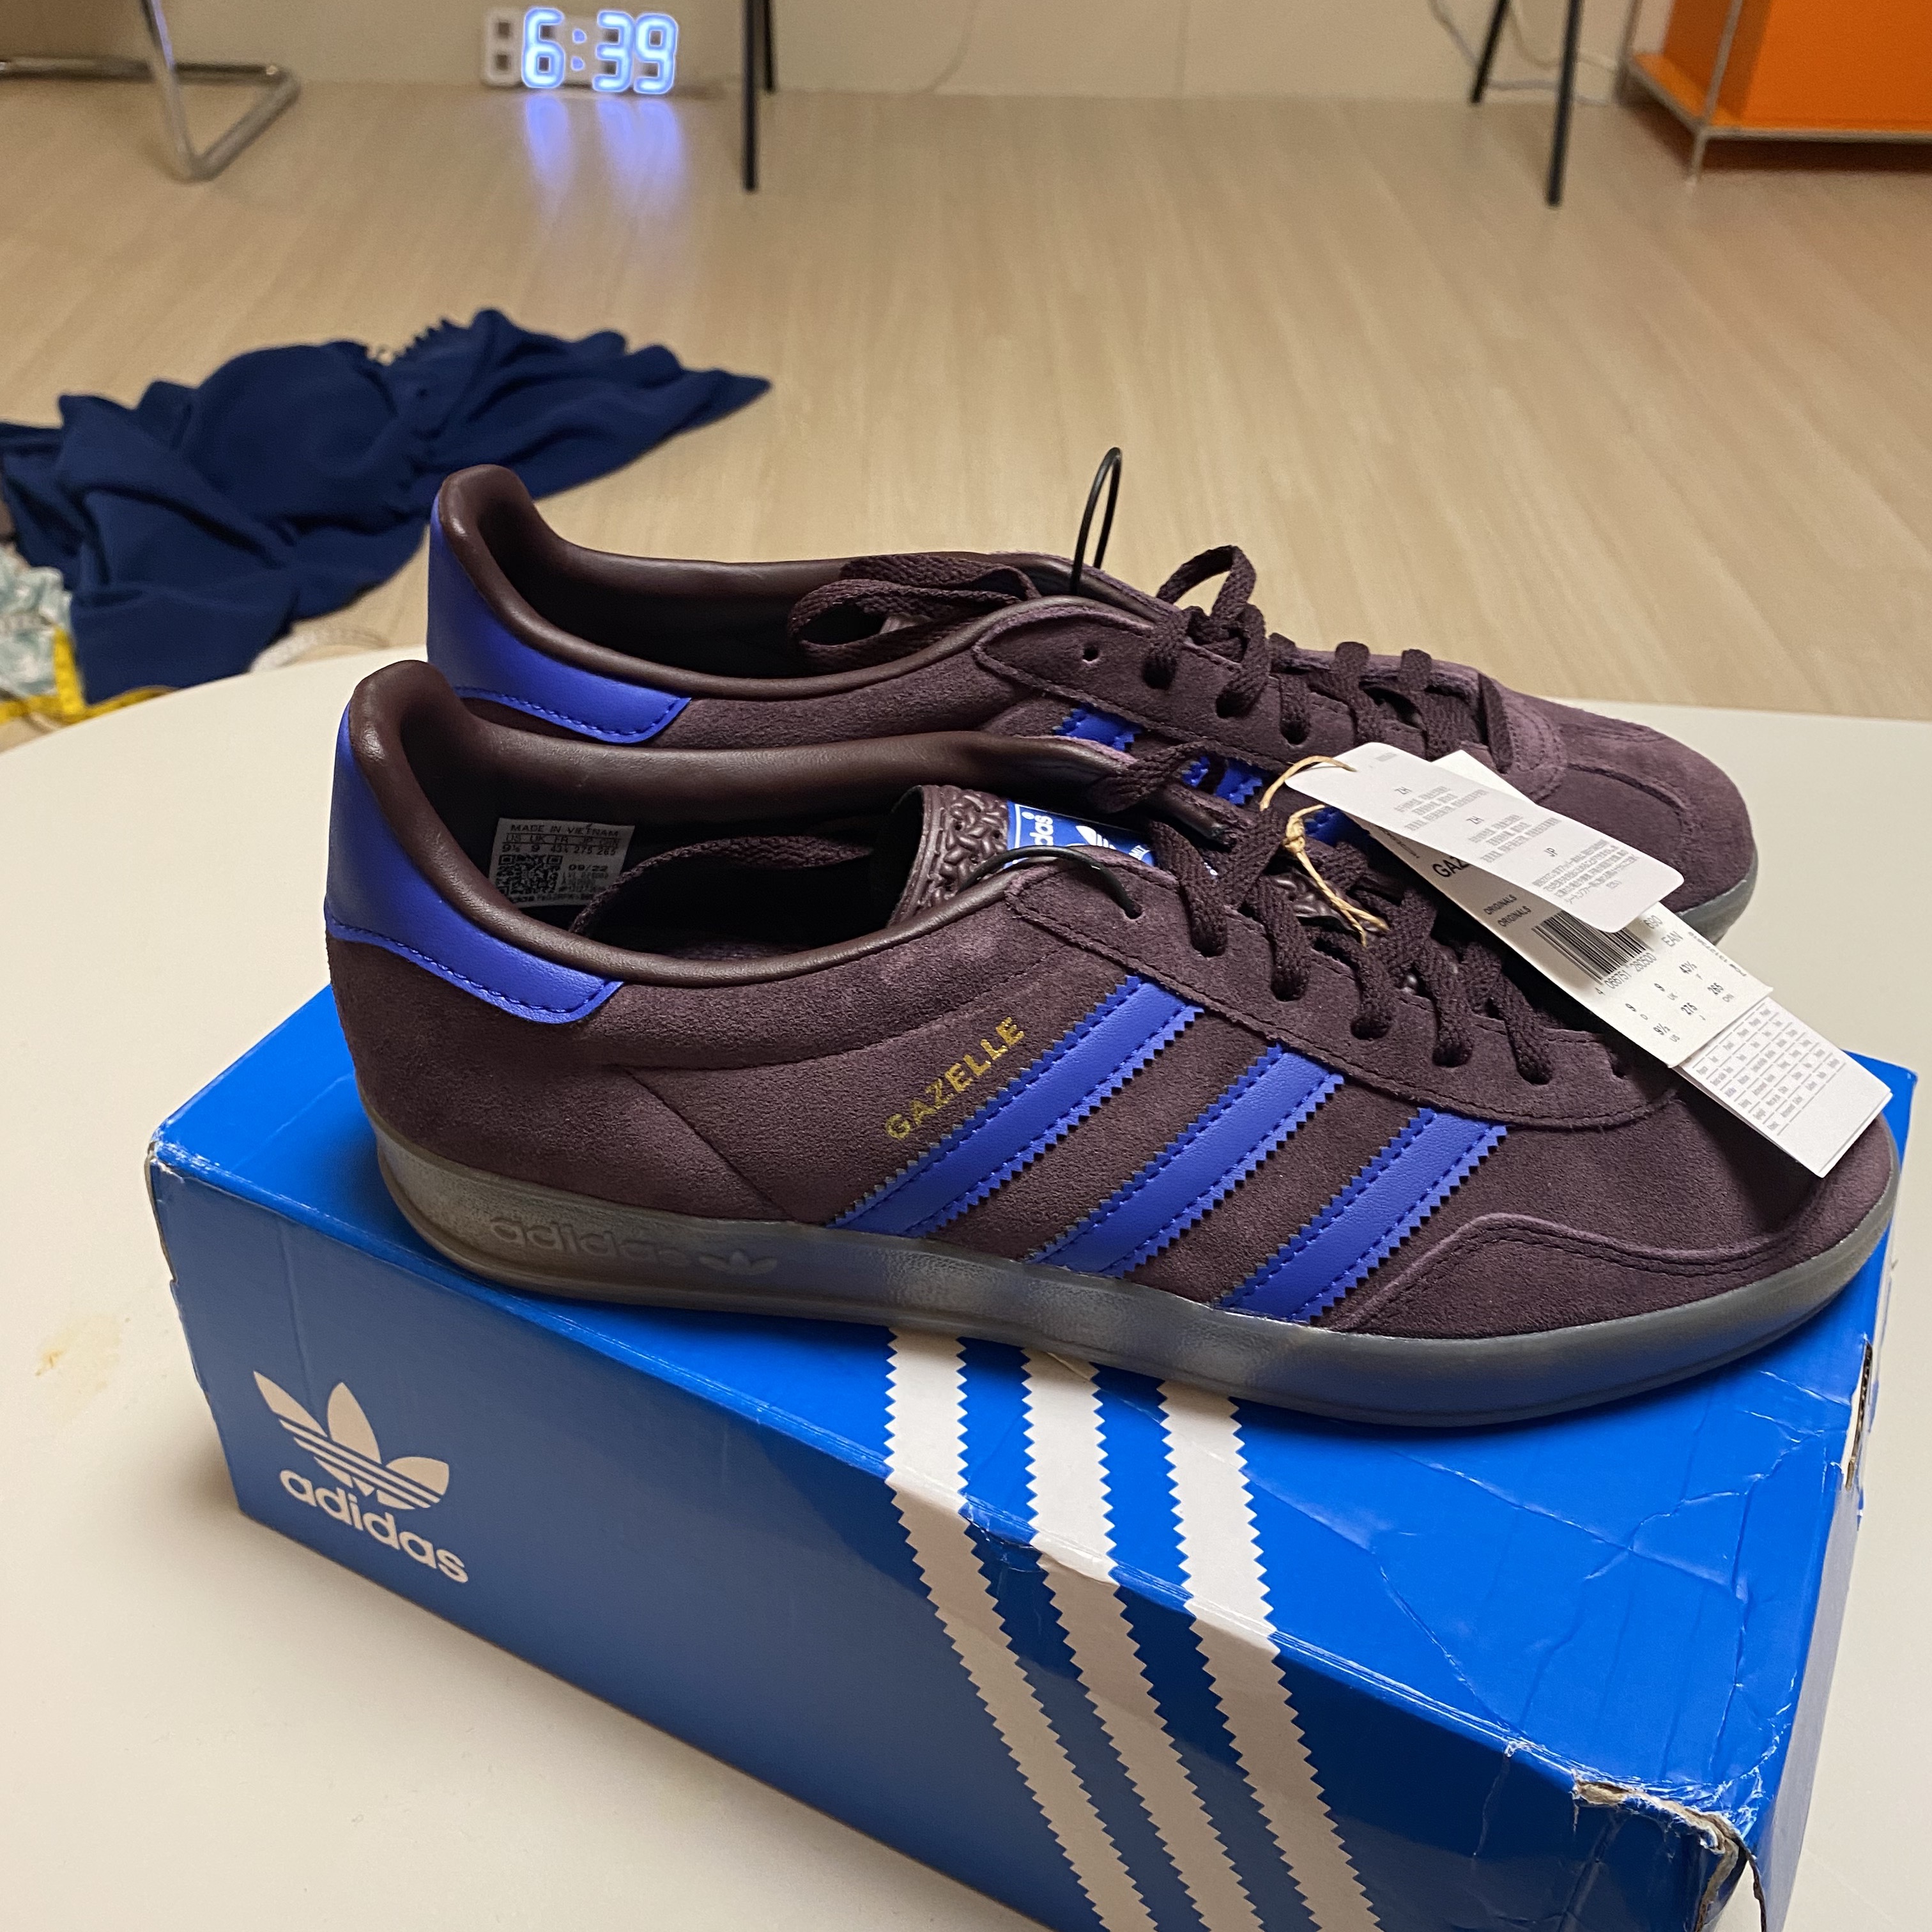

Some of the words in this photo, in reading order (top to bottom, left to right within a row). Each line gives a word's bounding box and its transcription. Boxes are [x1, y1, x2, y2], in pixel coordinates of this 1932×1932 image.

[521, 6, 678, 95] 6:39
[1466, 816, 1485, 825] ZH
[1544, 847, 1558, 857] JP
[1483, 894, 1517, 915] ORIGINALS
[1498, 905, 1531, 927] ORIGINALS
[1661, 930, 1683, 947] EAN
[1595, 987, 1606, 995] 4
[1604, 969, 1632, 989] 066751
[1630, 952, 1657, 972] 280500
[1625, 1003, 1637, 1012] 9
[1653, 983, 1666, 992] 9
[1680, 1002, 1698, 1016] 275
[1707, 983, 1724, 995] 265
[885, 1016, 1025, 1140] GAZELLE
[490, 1216, 693, 1268] adidas
[280, 1469, 468, 1583] adidas
